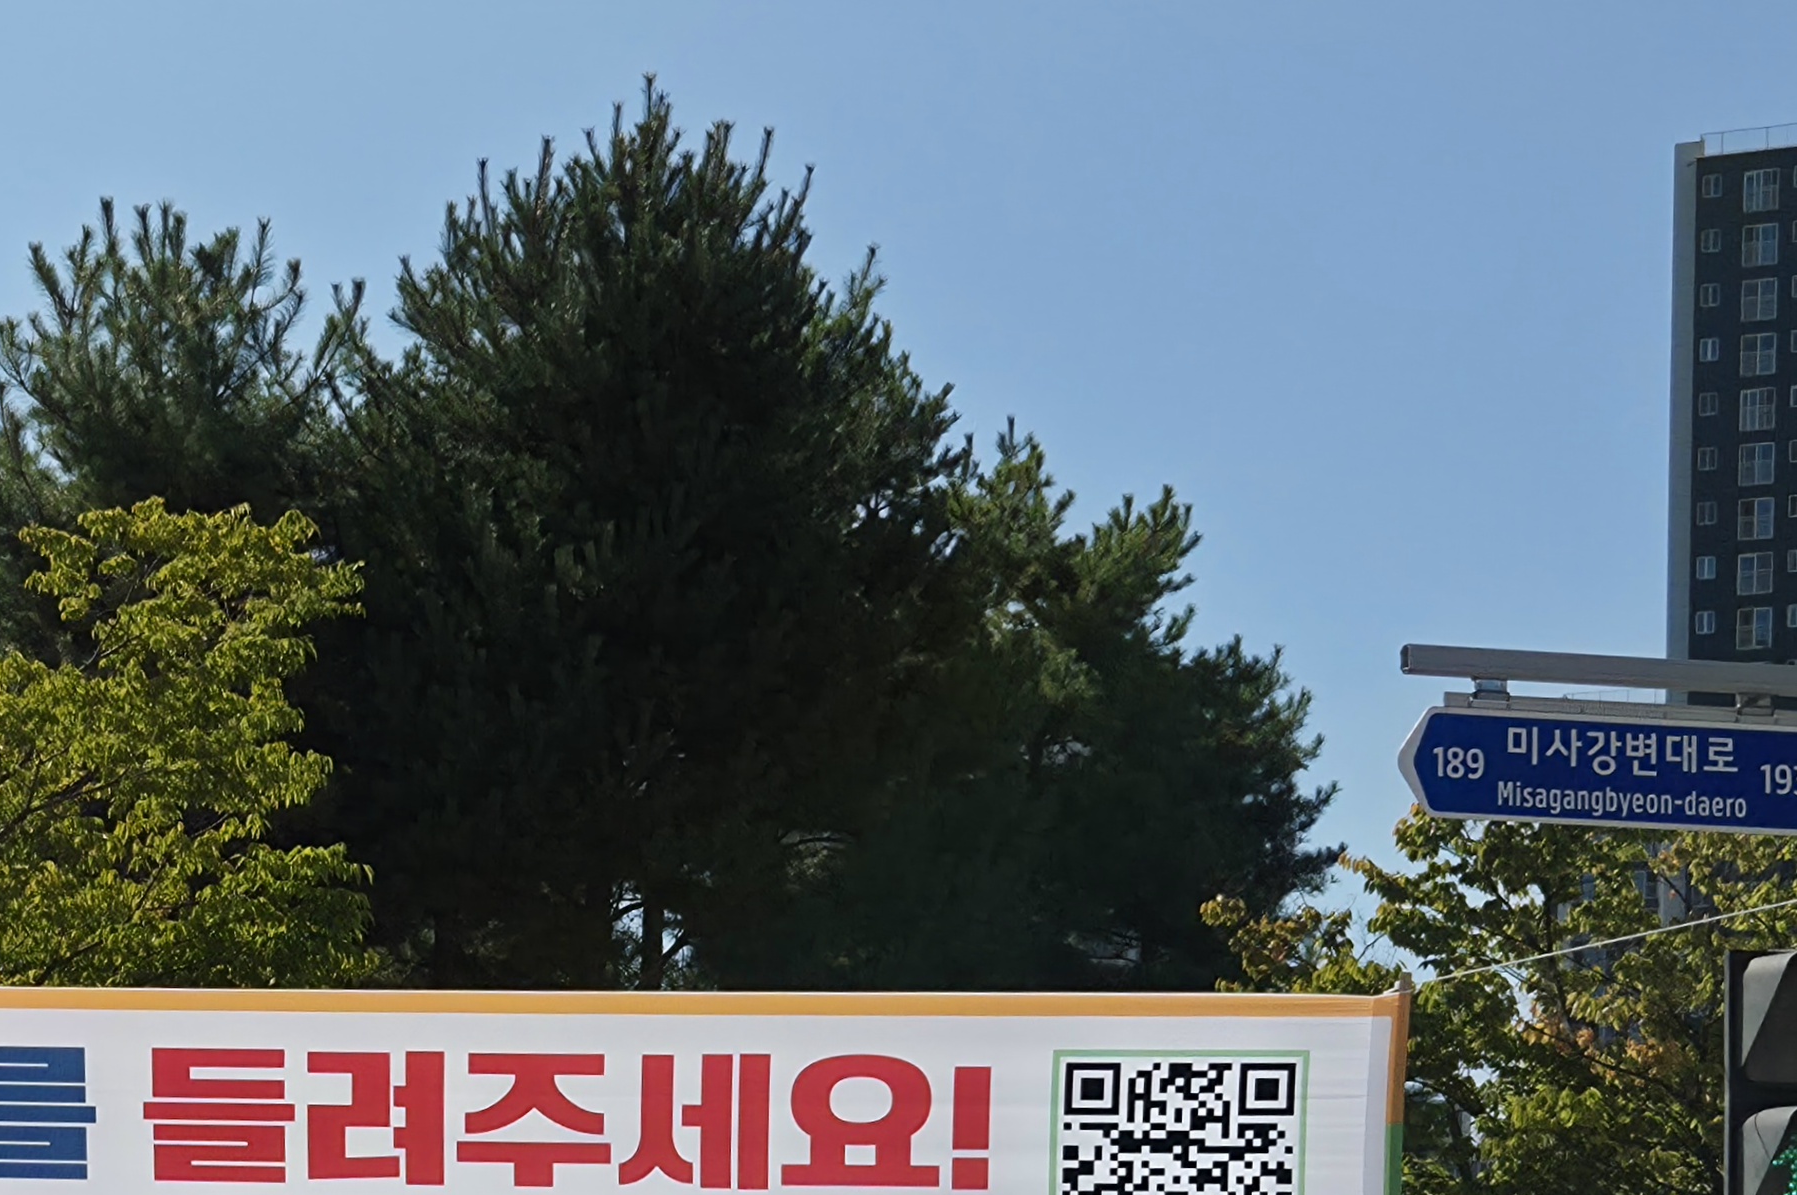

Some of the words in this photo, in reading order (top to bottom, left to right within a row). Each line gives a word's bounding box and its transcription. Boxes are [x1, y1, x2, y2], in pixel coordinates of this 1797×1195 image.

[1433, 746, 1485, 780] 189
[1507, 726, 1739, 777] 미사강변대로
[1760, 763, 1797, 796] 19
[1497, 781, 1747, 819] Misagangbyeon-daero
[143, 1047, 992, 1191] 들려주세요!
